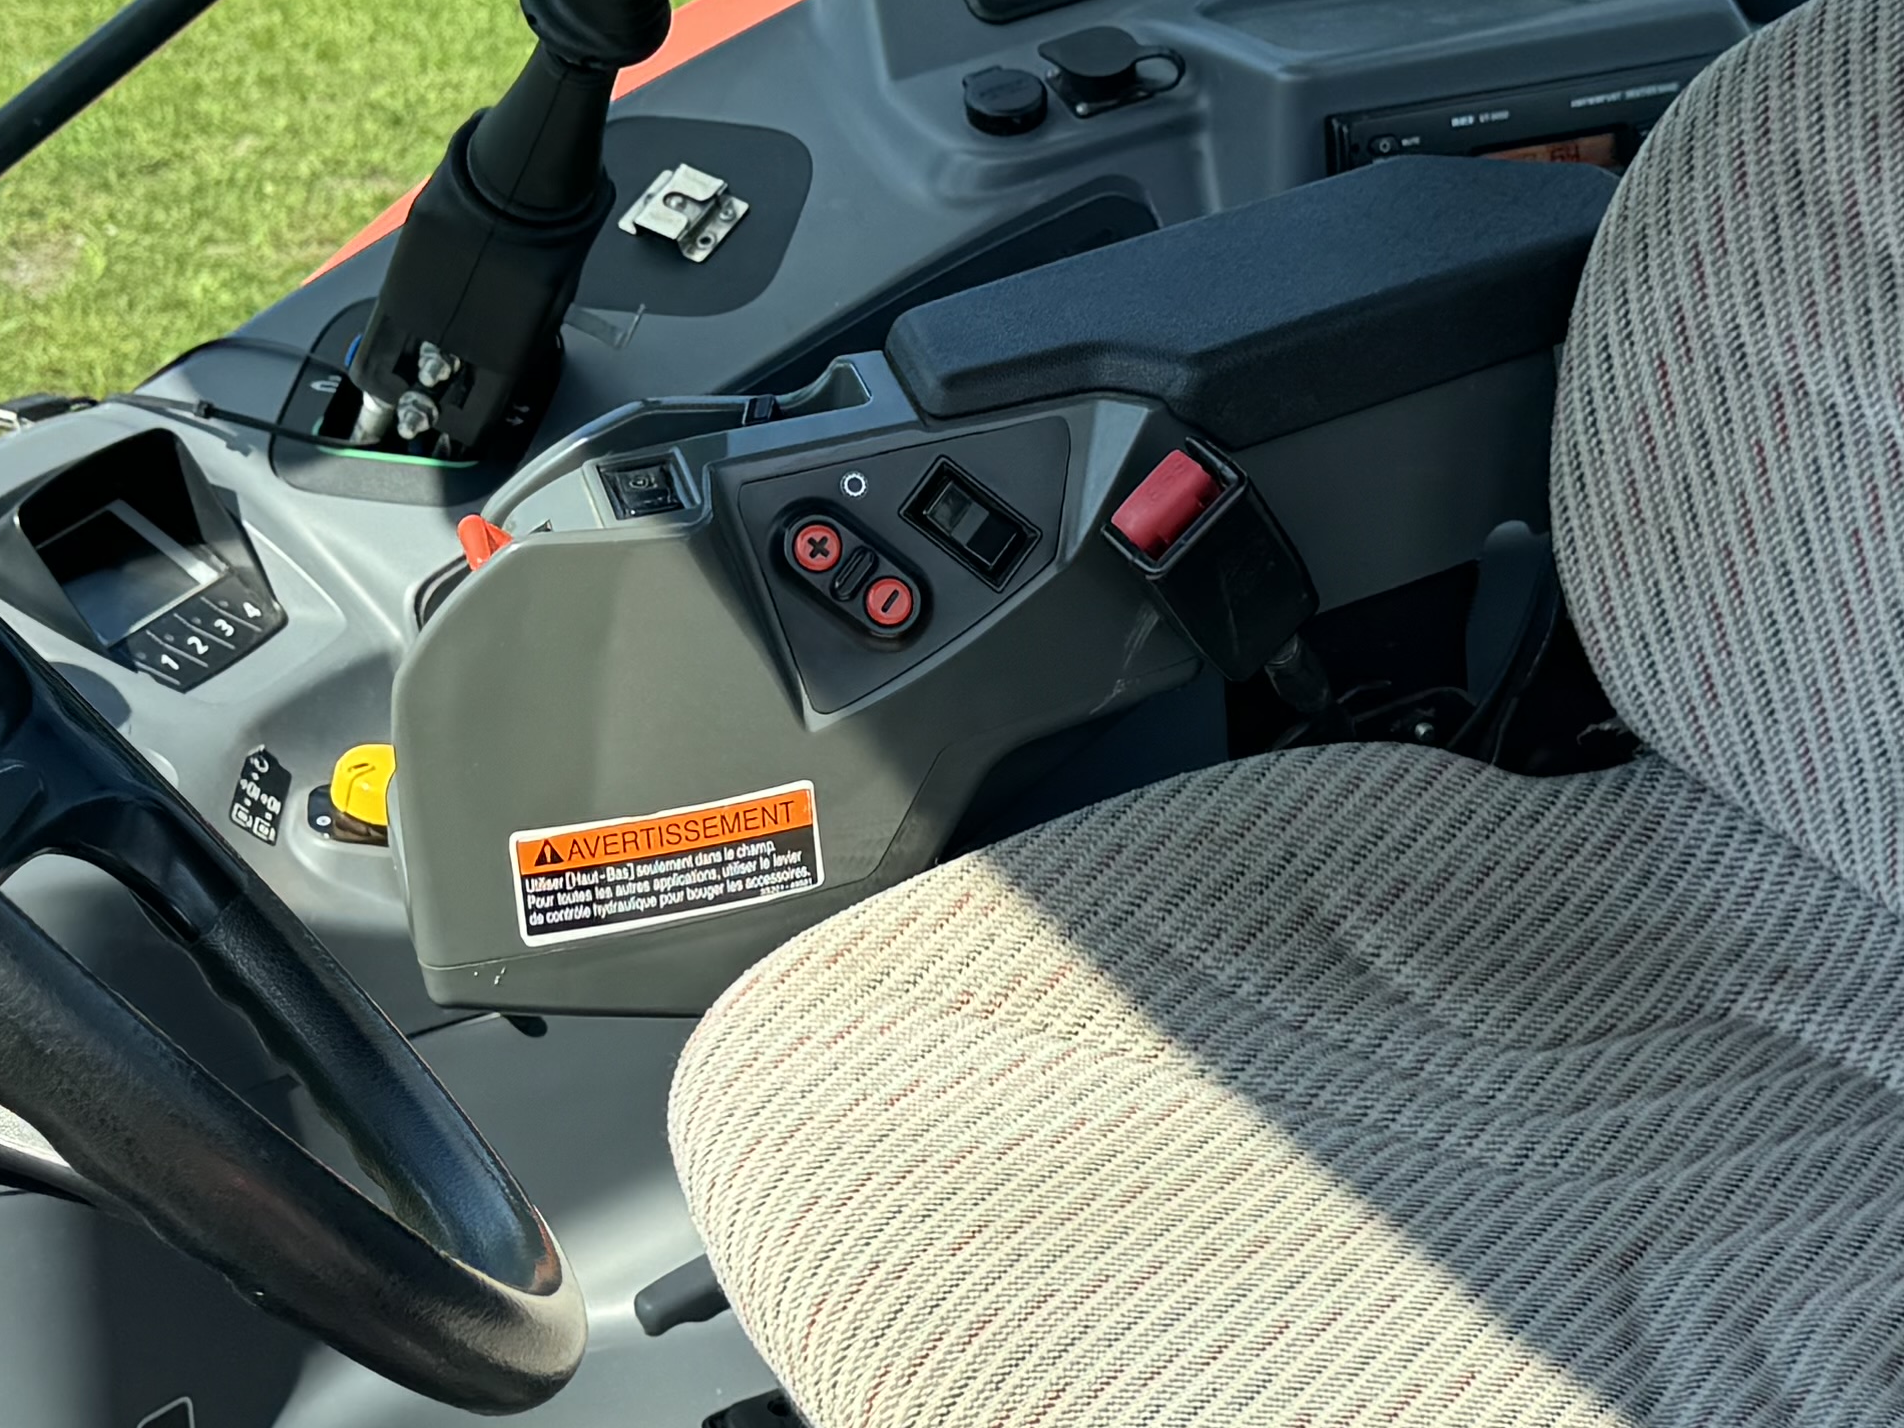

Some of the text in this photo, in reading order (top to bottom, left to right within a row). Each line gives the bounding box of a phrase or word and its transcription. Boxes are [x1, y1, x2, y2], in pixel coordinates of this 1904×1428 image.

[161, 601, 262, 671] 1 2 3 4
[567, 799, 795, 861] AVERTISSEMENT
[527, 849, 803, 909] Pour toutes les autres applications, utiliser le levier
[637, 852, 693, 876] seulement
[695, 849, 722, 865] dans
[724, 846, 734, 860] le
[529, 911, 544, 926] de
[593, 895, 657, 919] hydraulique
[660, 889, 684, 909] pour
[686, 884, 725, 902] bouger
[726, 877, 744, 893] les
